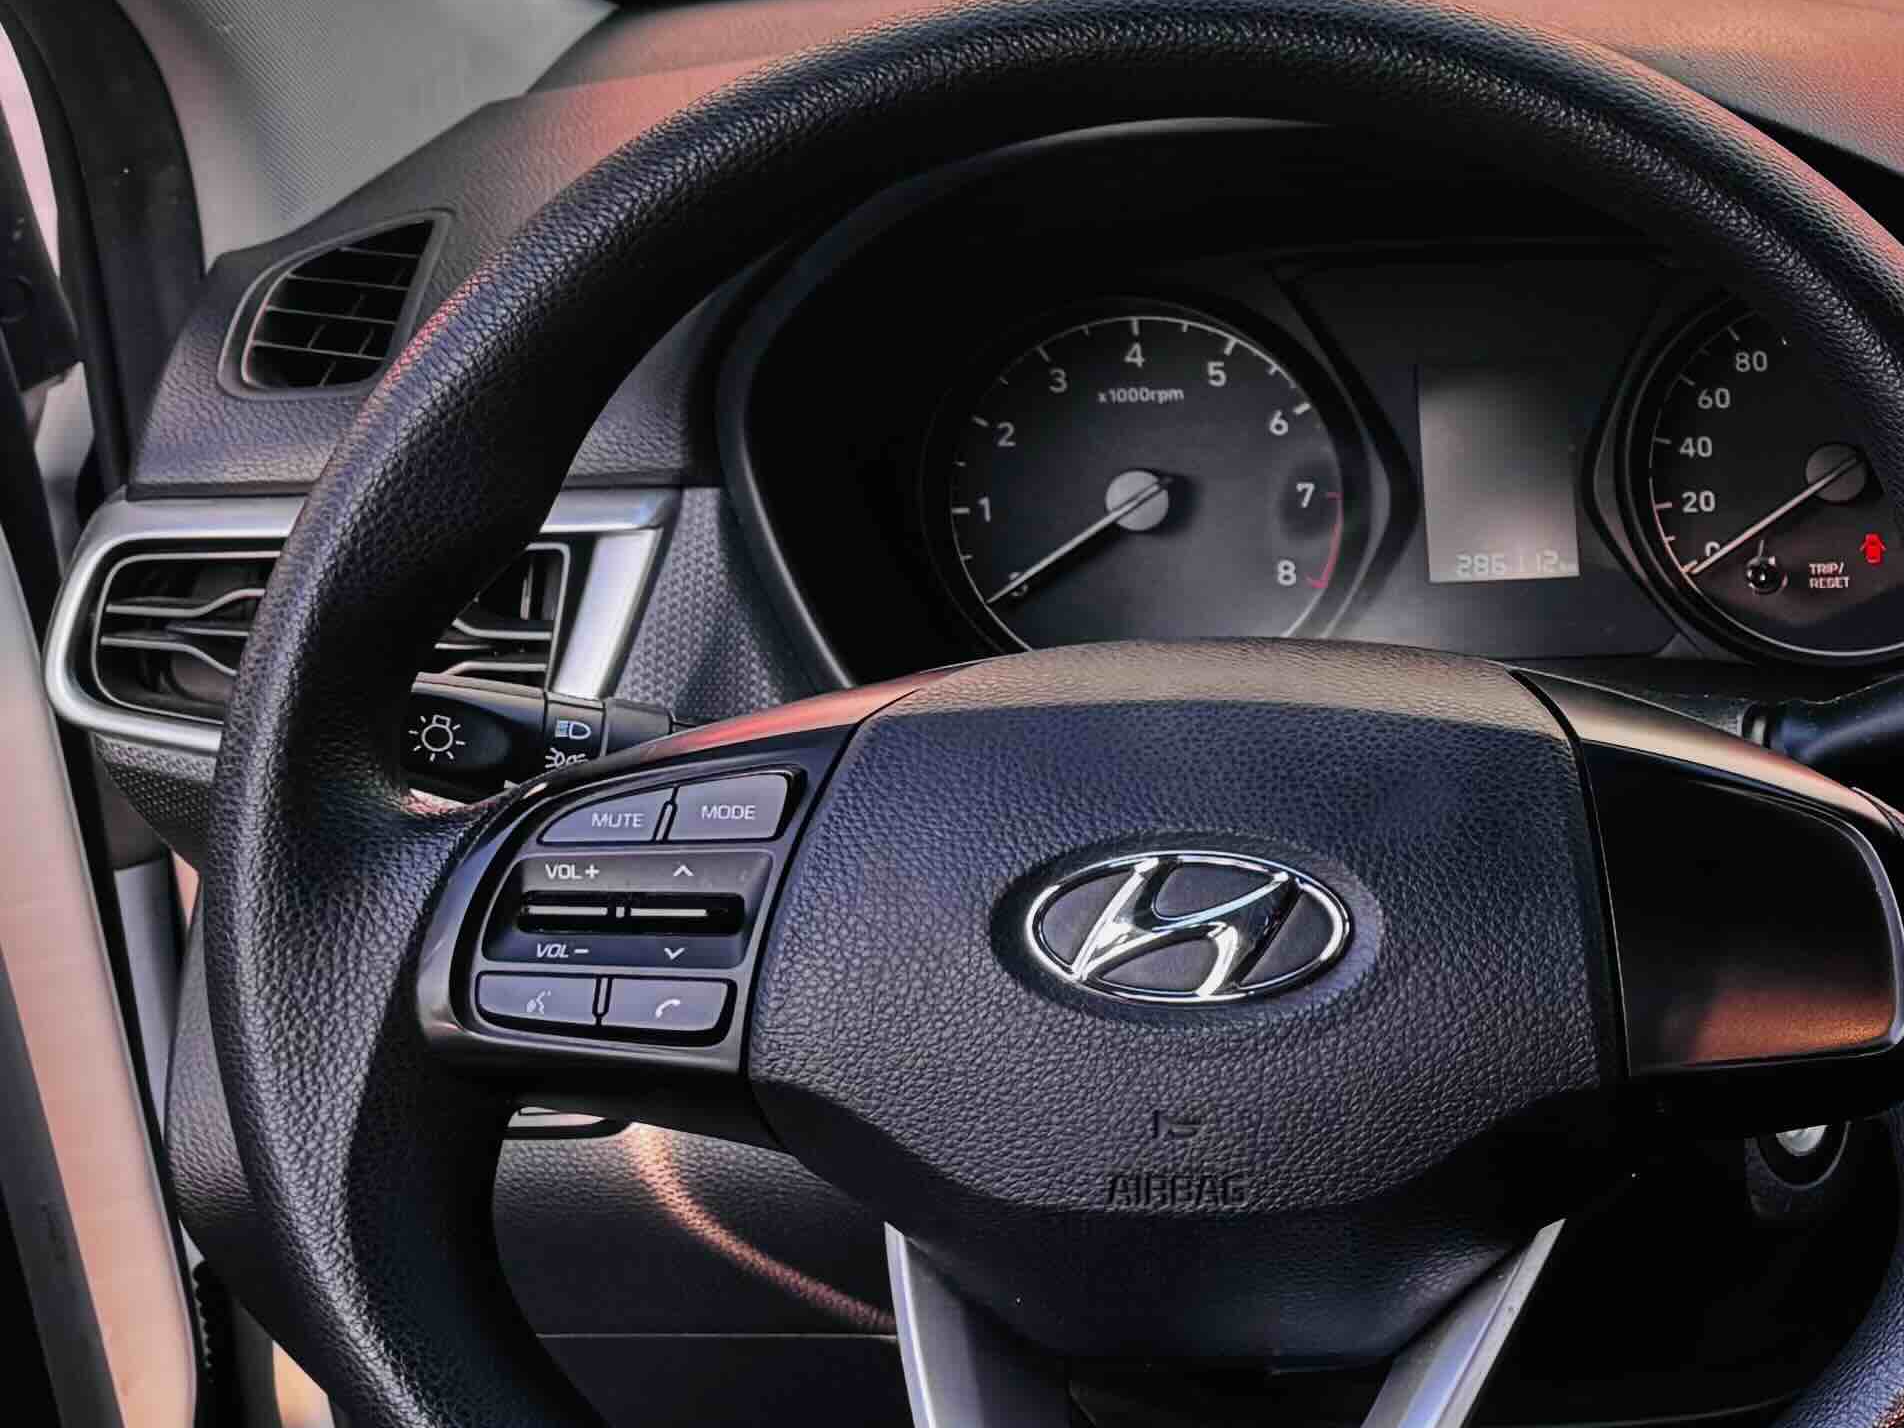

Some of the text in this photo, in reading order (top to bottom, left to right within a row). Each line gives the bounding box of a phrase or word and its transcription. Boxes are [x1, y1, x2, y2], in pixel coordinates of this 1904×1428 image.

[1124, 342, 1145, 368] 4
[1735, 350, 1768, 373] 80
[1049, 368, 1068, 394] 3
[1207, 361, 1227, 387] 5
[1697, 387, 1731, 410] 60
[997, 421, 1017, 447] 2
[1269, 410, 1289, 436] 6
[1679, 435, 1713, 458] 40
[1295, 482, 1315, 509] 7
[1682, 490, 1716, 513] 20
[978, 496, 991, 522] 1
[1277, 559, 1297, 586] 8
[591, 812, 644, 828] MUTE
[701, 804, 756, 821] MODE
[1107, 1172, 1246, 1206] AIRBAG
